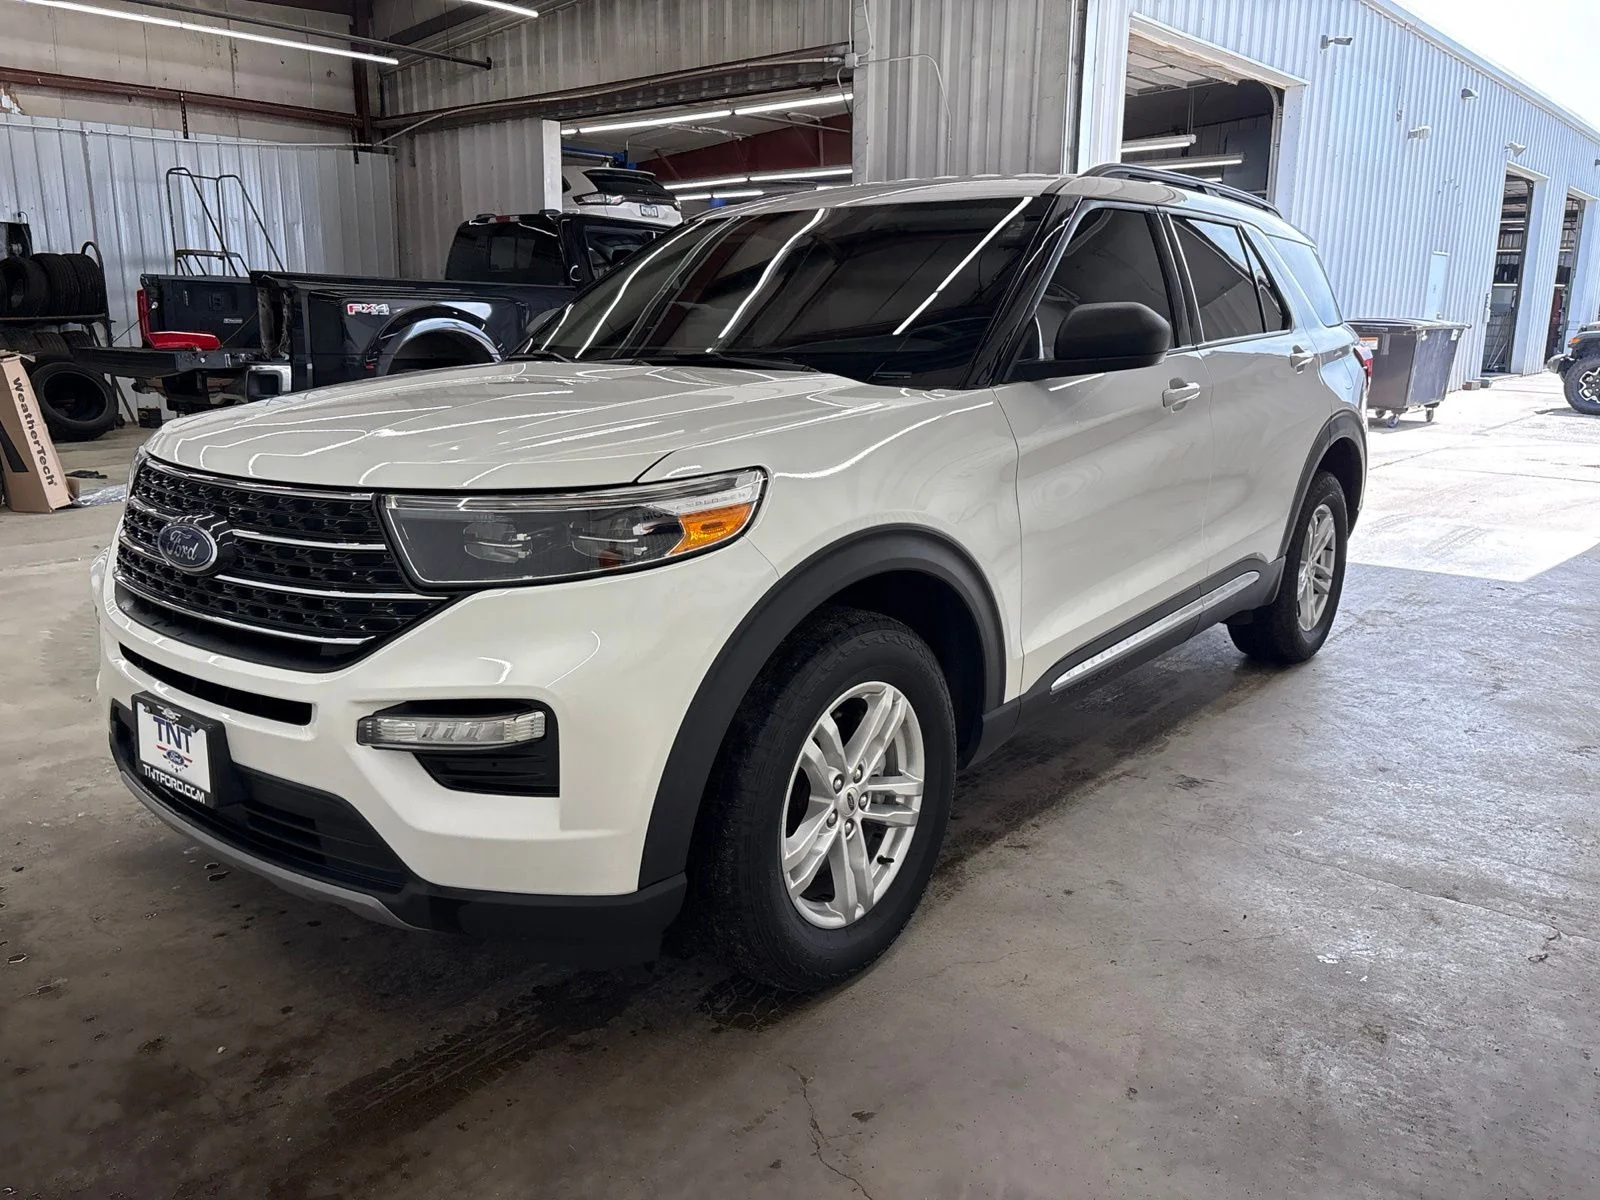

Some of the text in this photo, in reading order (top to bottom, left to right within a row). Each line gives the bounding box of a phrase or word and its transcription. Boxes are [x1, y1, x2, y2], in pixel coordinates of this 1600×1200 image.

[347, 303, 389, 315] FX4
[13, 376, 56, 486] WeatherTech
[166, 530, 198, 560] Ford
[153, 716, 192, 753] TNT
[142, 764, 205, 804] TNTFORD.COM
